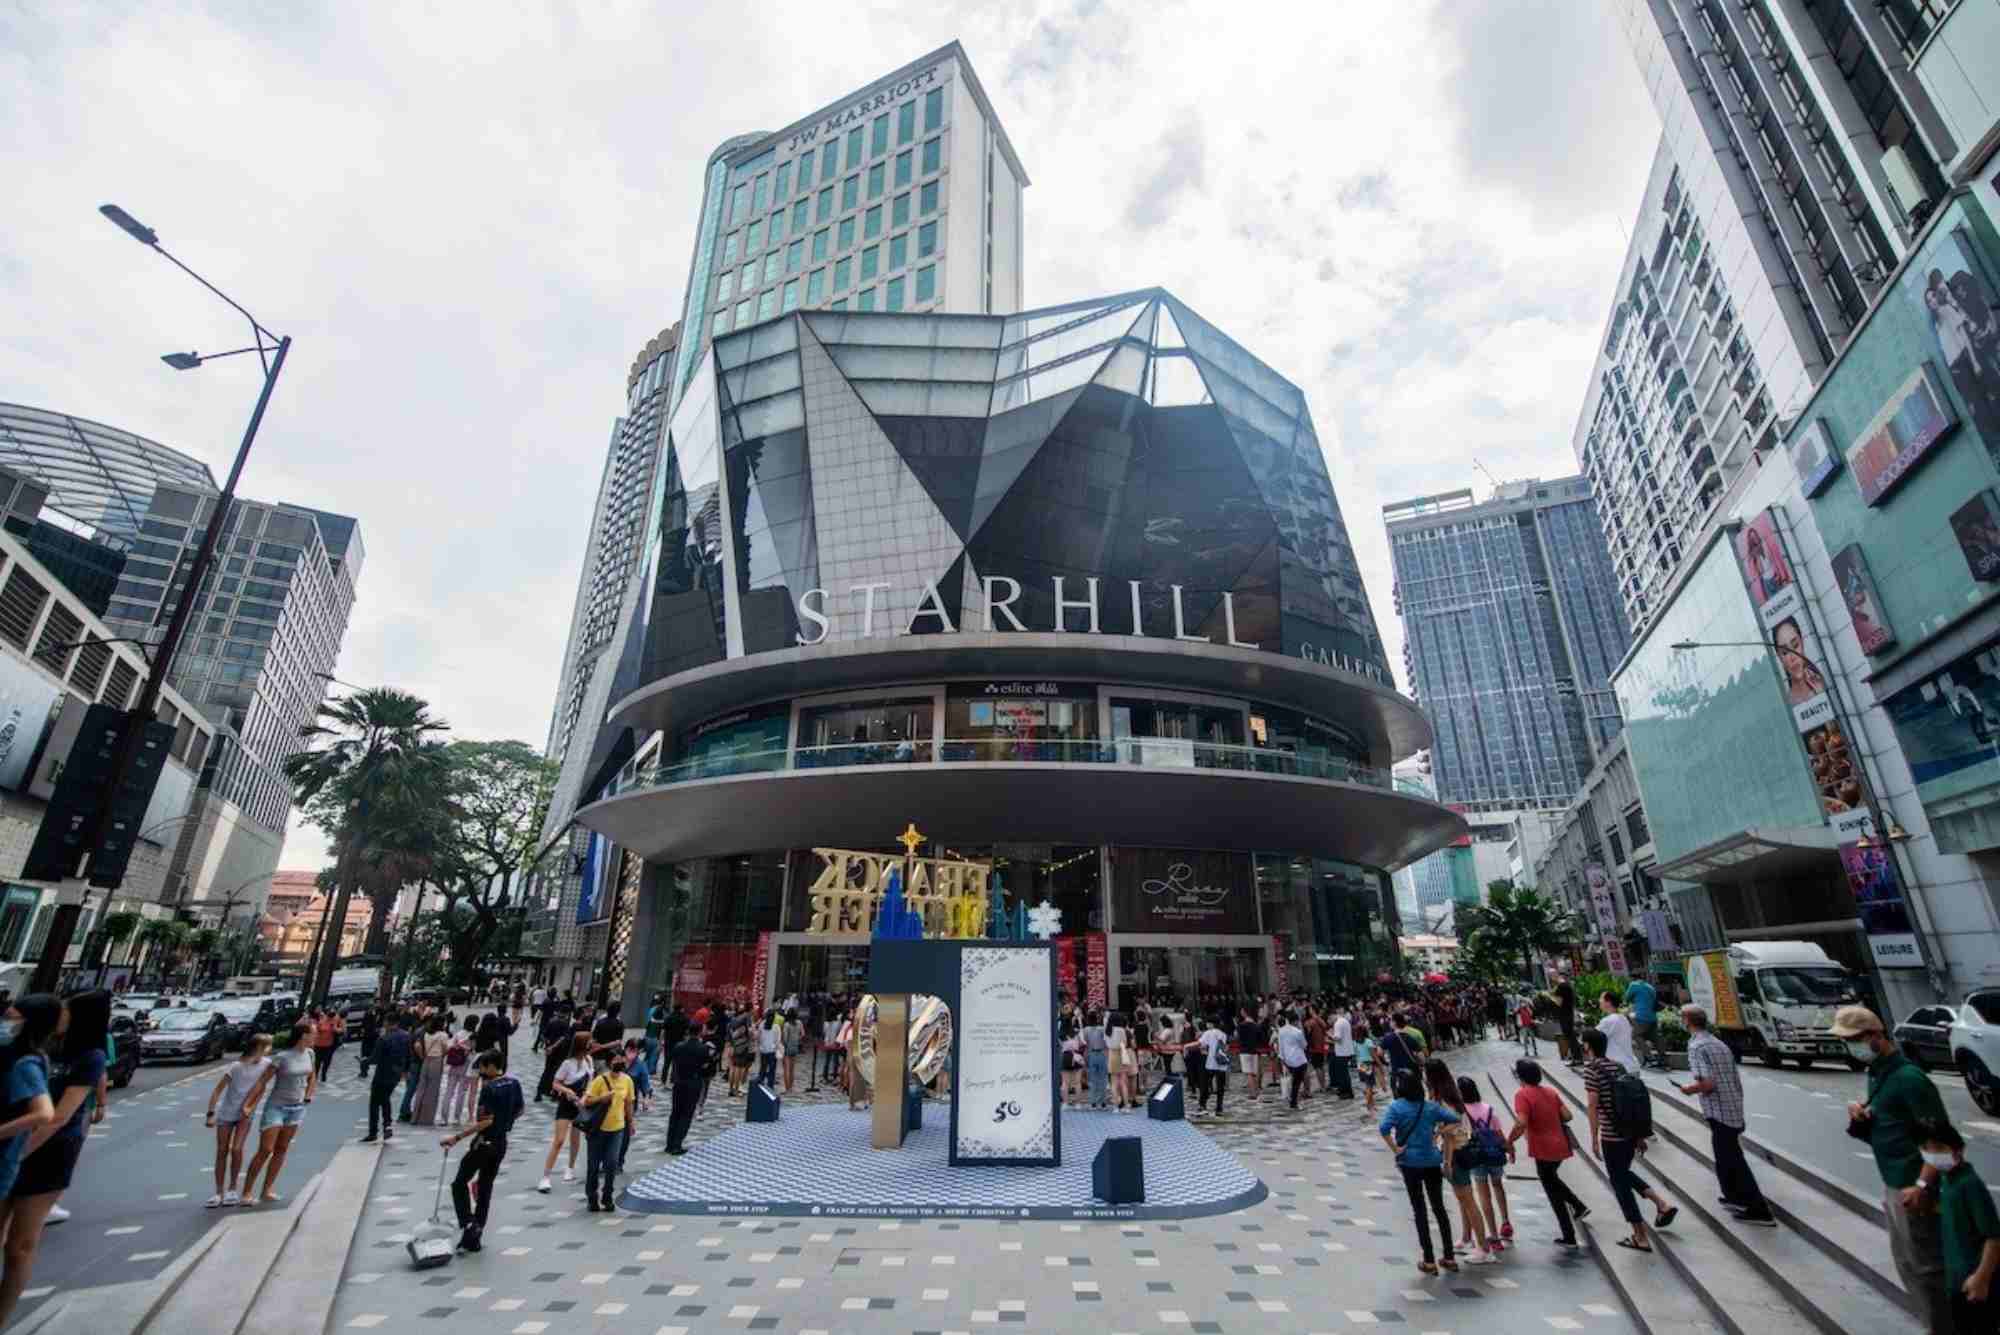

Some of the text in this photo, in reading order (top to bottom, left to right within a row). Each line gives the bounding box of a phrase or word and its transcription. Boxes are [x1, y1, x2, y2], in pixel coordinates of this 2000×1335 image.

[789, 66, 938, 151] JW MARRIOTT
[795, 574, 1261, 649] STARHILL
[1765, 594, 1793, 619] FASHION
[1300, 641, 1385, 688] GALLERY
[1800, 702, 1829, 720] BEAUTY
[1839, 816, 1869, 832] DINING
[1875, 943, 1915, 956] LEISURE
